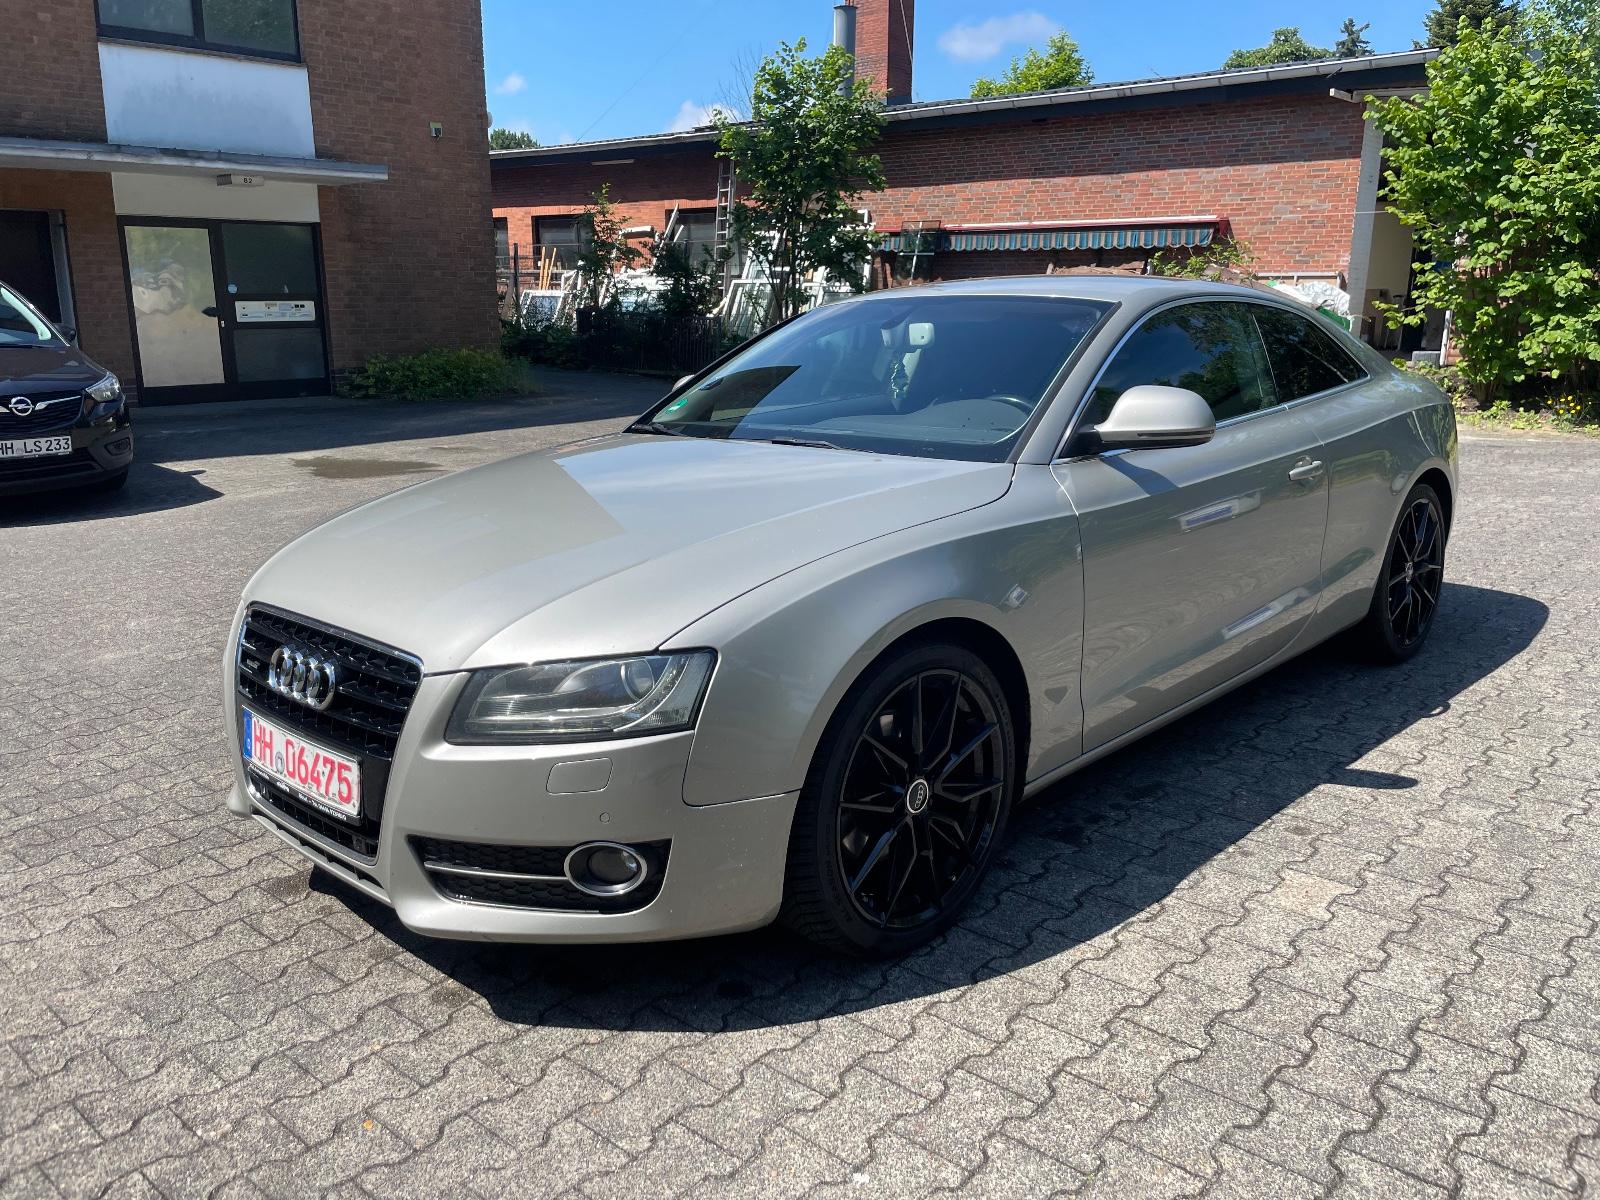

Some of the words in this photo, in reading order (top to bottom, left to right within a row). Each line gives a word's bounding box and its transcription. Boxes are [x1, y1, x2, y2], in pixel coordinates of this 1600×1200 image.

[24, 440, 42, 453] LS
[45, 438, 70, 451] 233
[253, 719, 273, 768] HH
[285, 738, 352, 805] 06475
